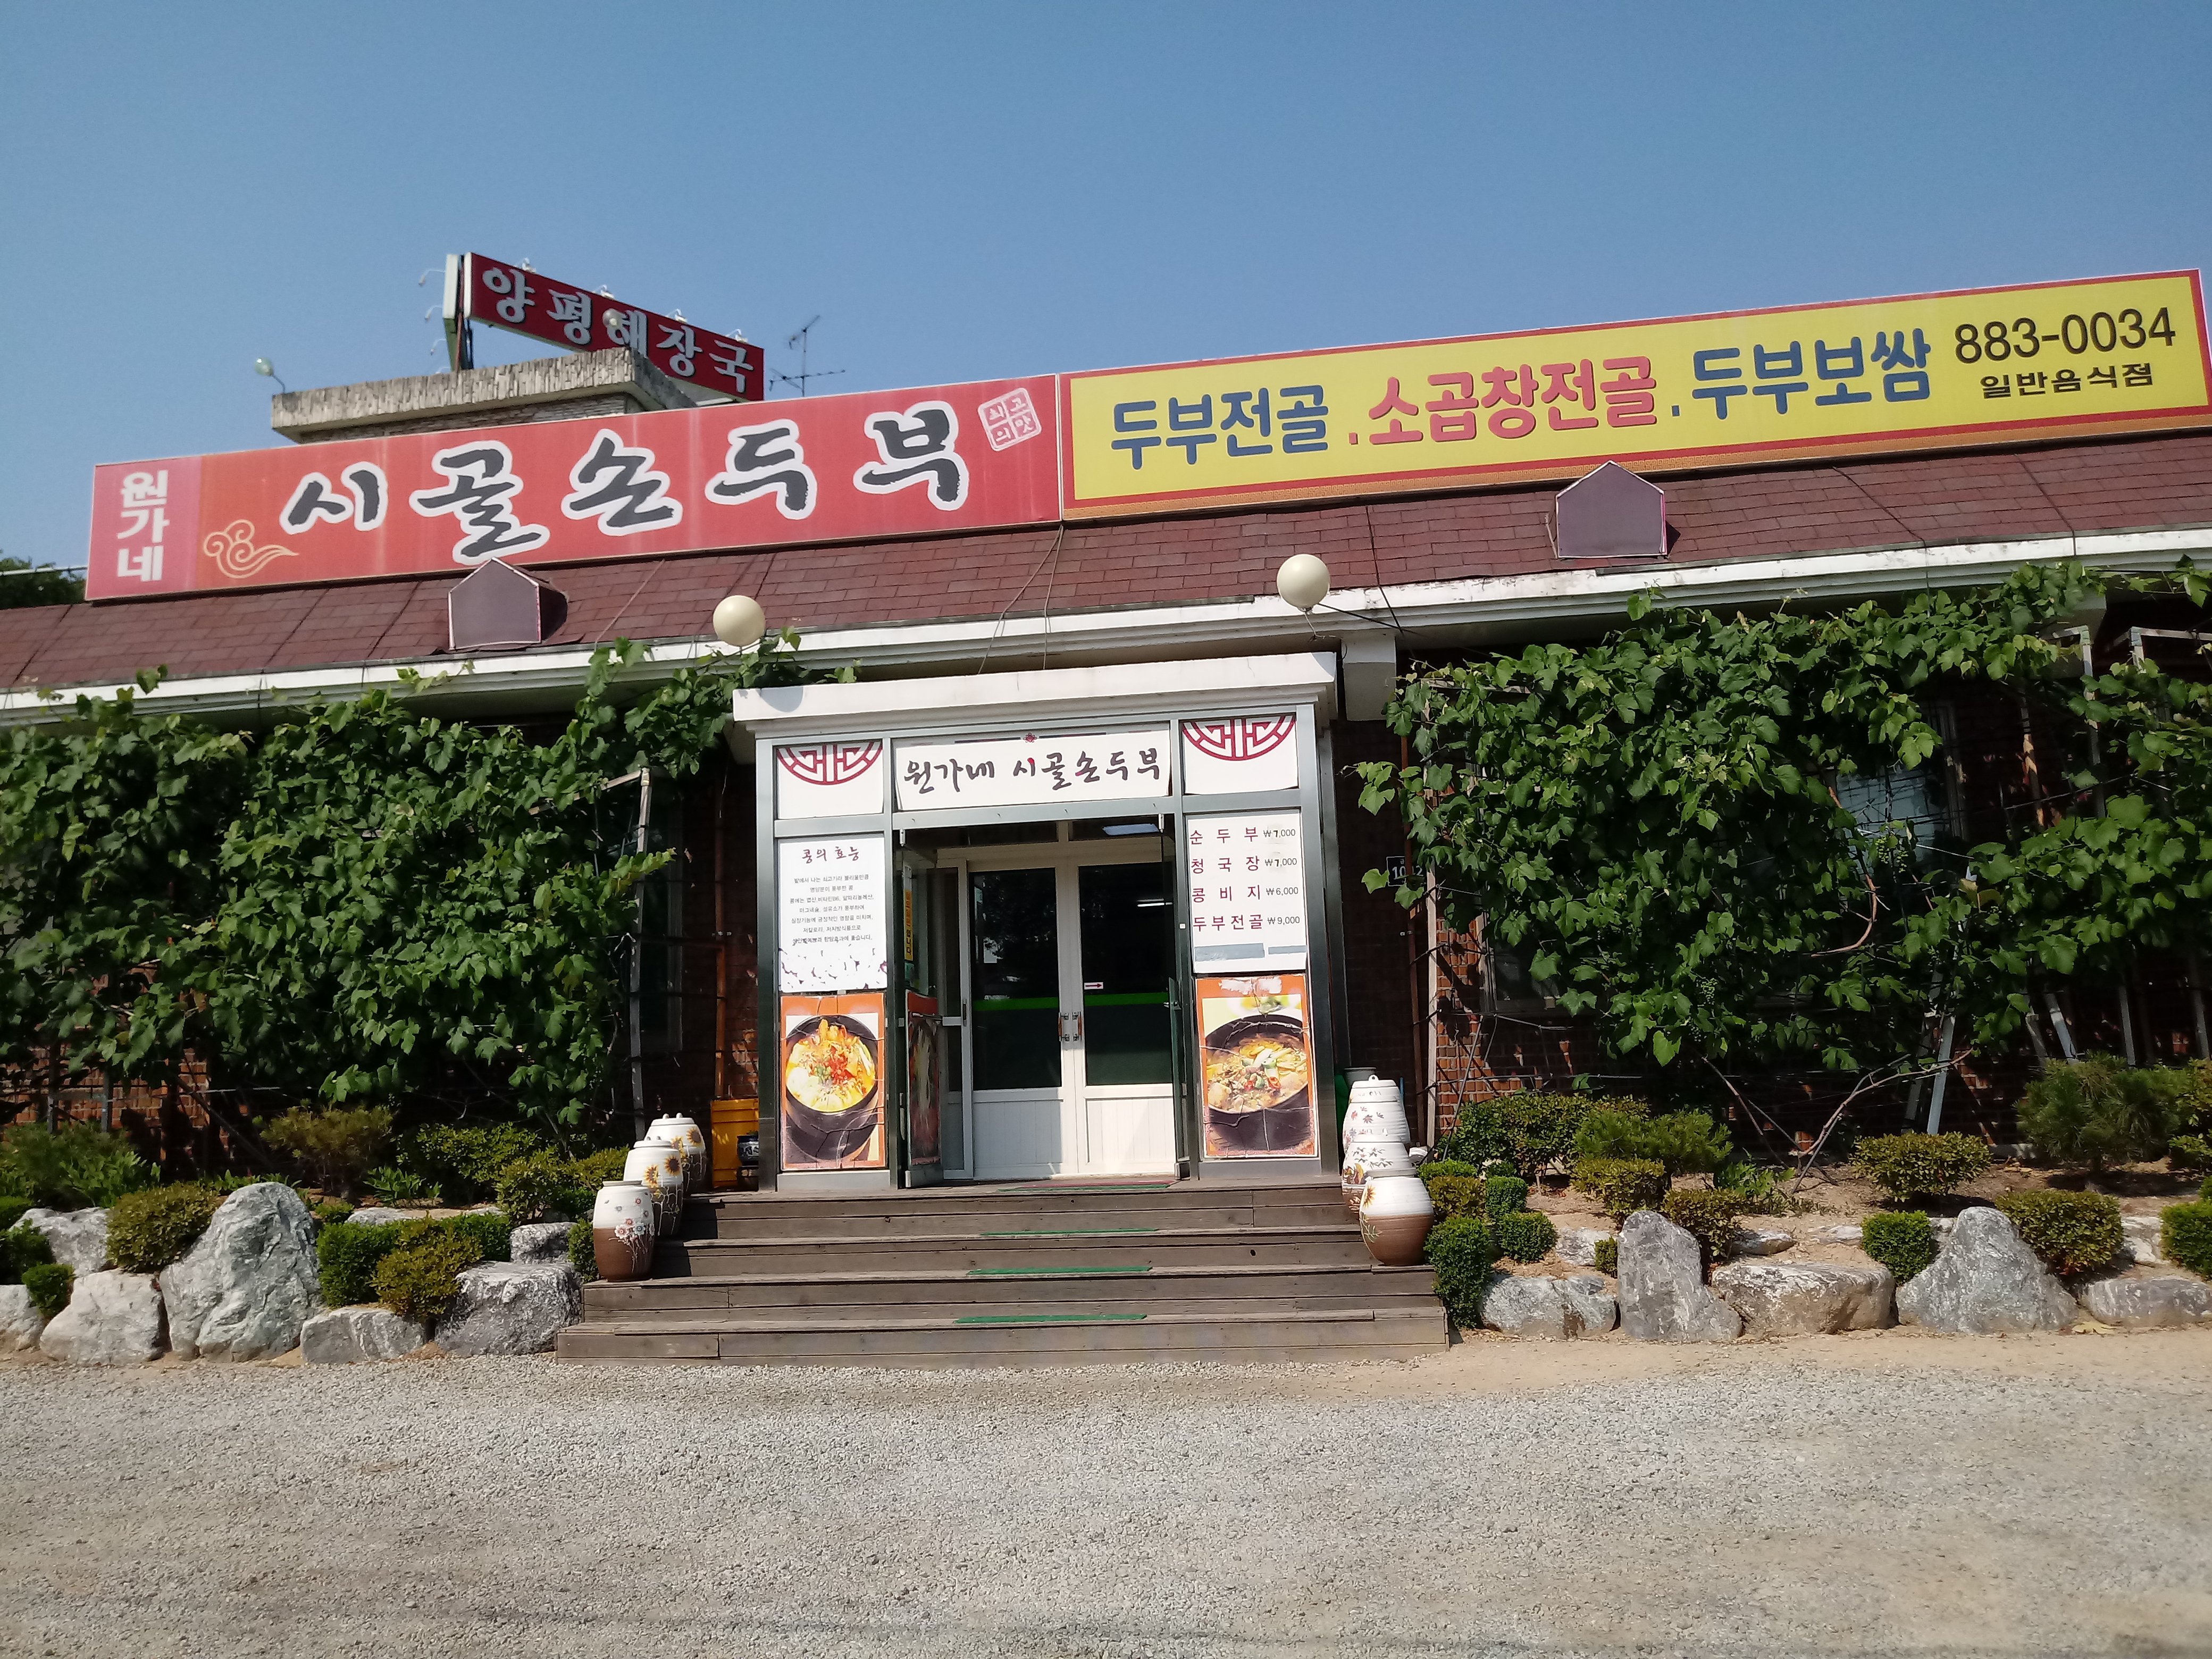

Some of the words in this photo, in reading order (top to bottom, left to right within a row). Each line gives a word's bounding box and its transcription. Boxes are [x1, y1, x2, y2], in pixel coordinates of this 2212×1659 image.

[482, 267, 753, 393] 양평해장국
[1955, 307, 2176, 364] 883-0034
[1111, 384, 1329, 470] 두부전골
[1692, 328, 1931, 420] 두부보쌈
[1980, 363, 2153, 399] 일반음식점
[117, 470, 171, 582] 원가네
[904, 758, 994, 794] 원가네
[802, 849, 827, 864] 콩의
[835, 846, 859, 861] 효능
